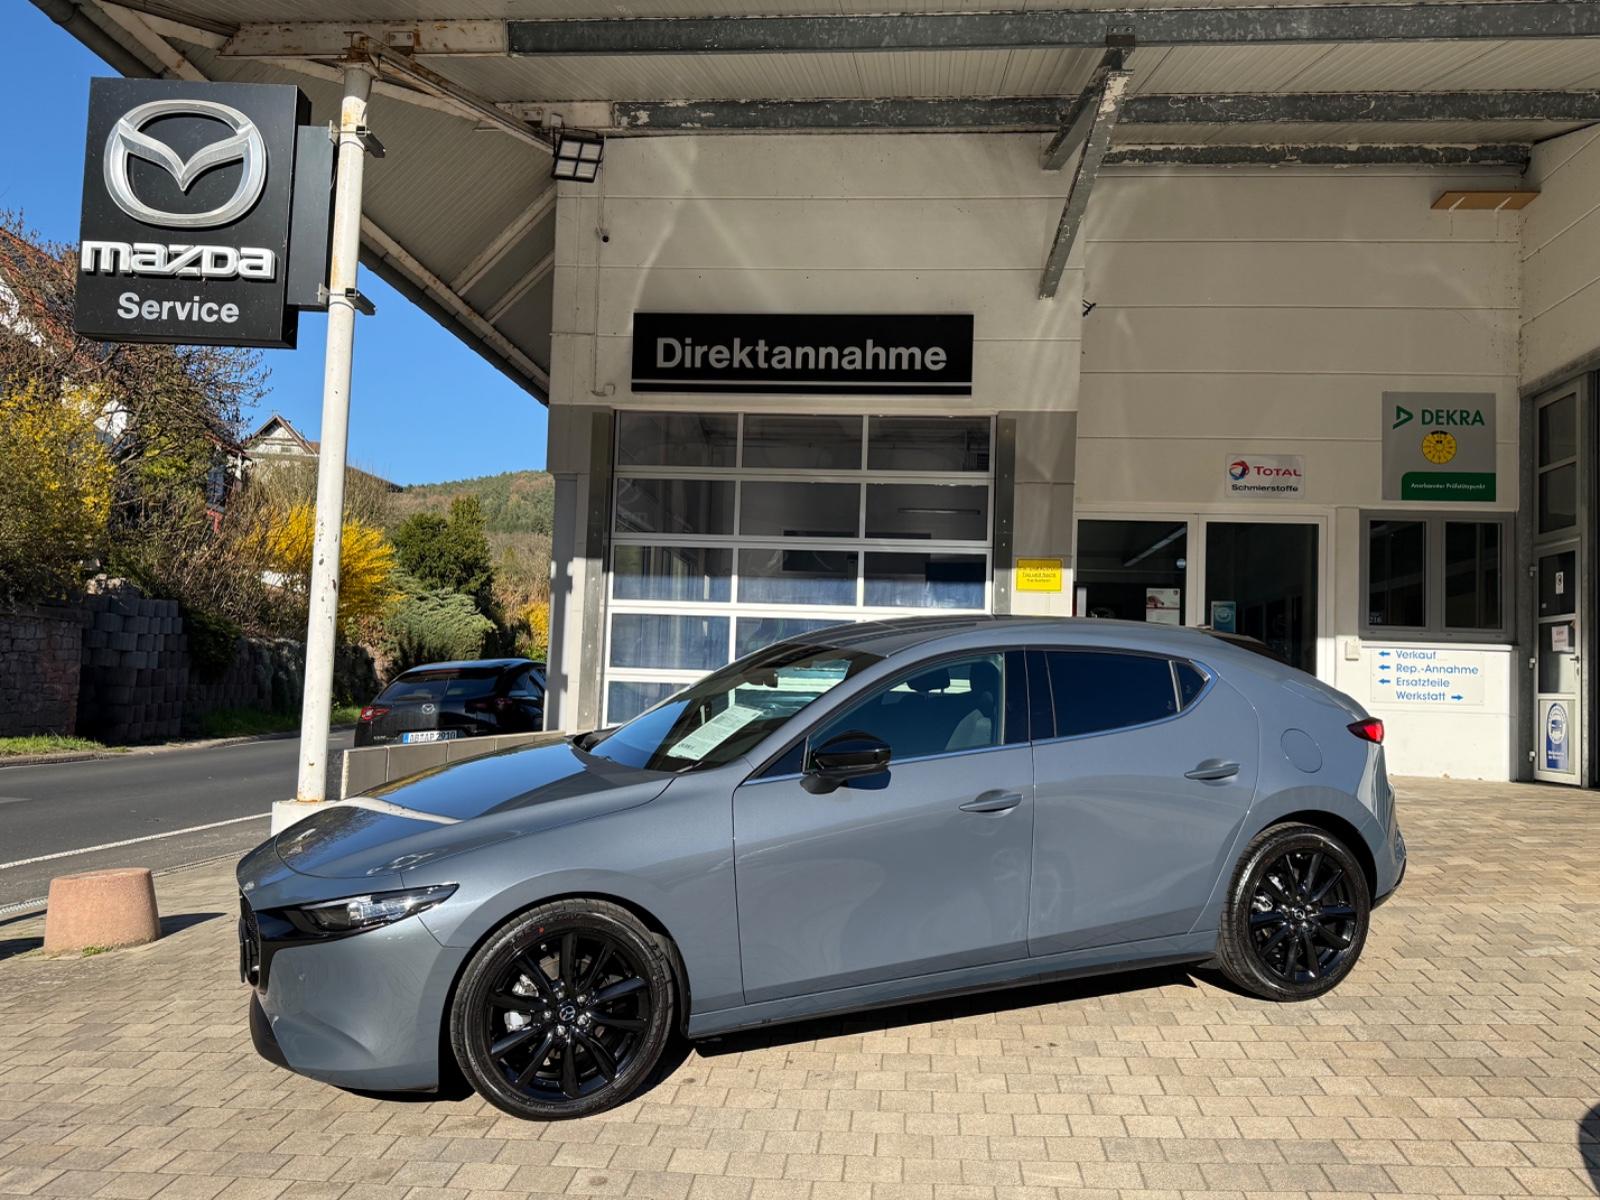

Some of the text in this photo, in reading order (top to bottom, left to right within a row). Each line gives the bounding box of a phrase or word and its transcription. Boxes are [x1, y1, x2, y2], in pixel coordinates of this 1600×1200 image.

[117, 292, 239, 323] Service
[656, 337, 948, 371] Direktannahme
[1421, 408, 1485, 426] DEKRA
[1254, 465, 1302, 477] TOTAL
[1231, 483, 1299, 492] Schmierstoffe
[1396, 650, 1436, 660] Verkauf
[1396, 664, 1479, 675] Rep.-Annahme
[1396, 677, 1450, 687] Ersatzteile
[1395, 690, 1446, 701] Werkstatt
